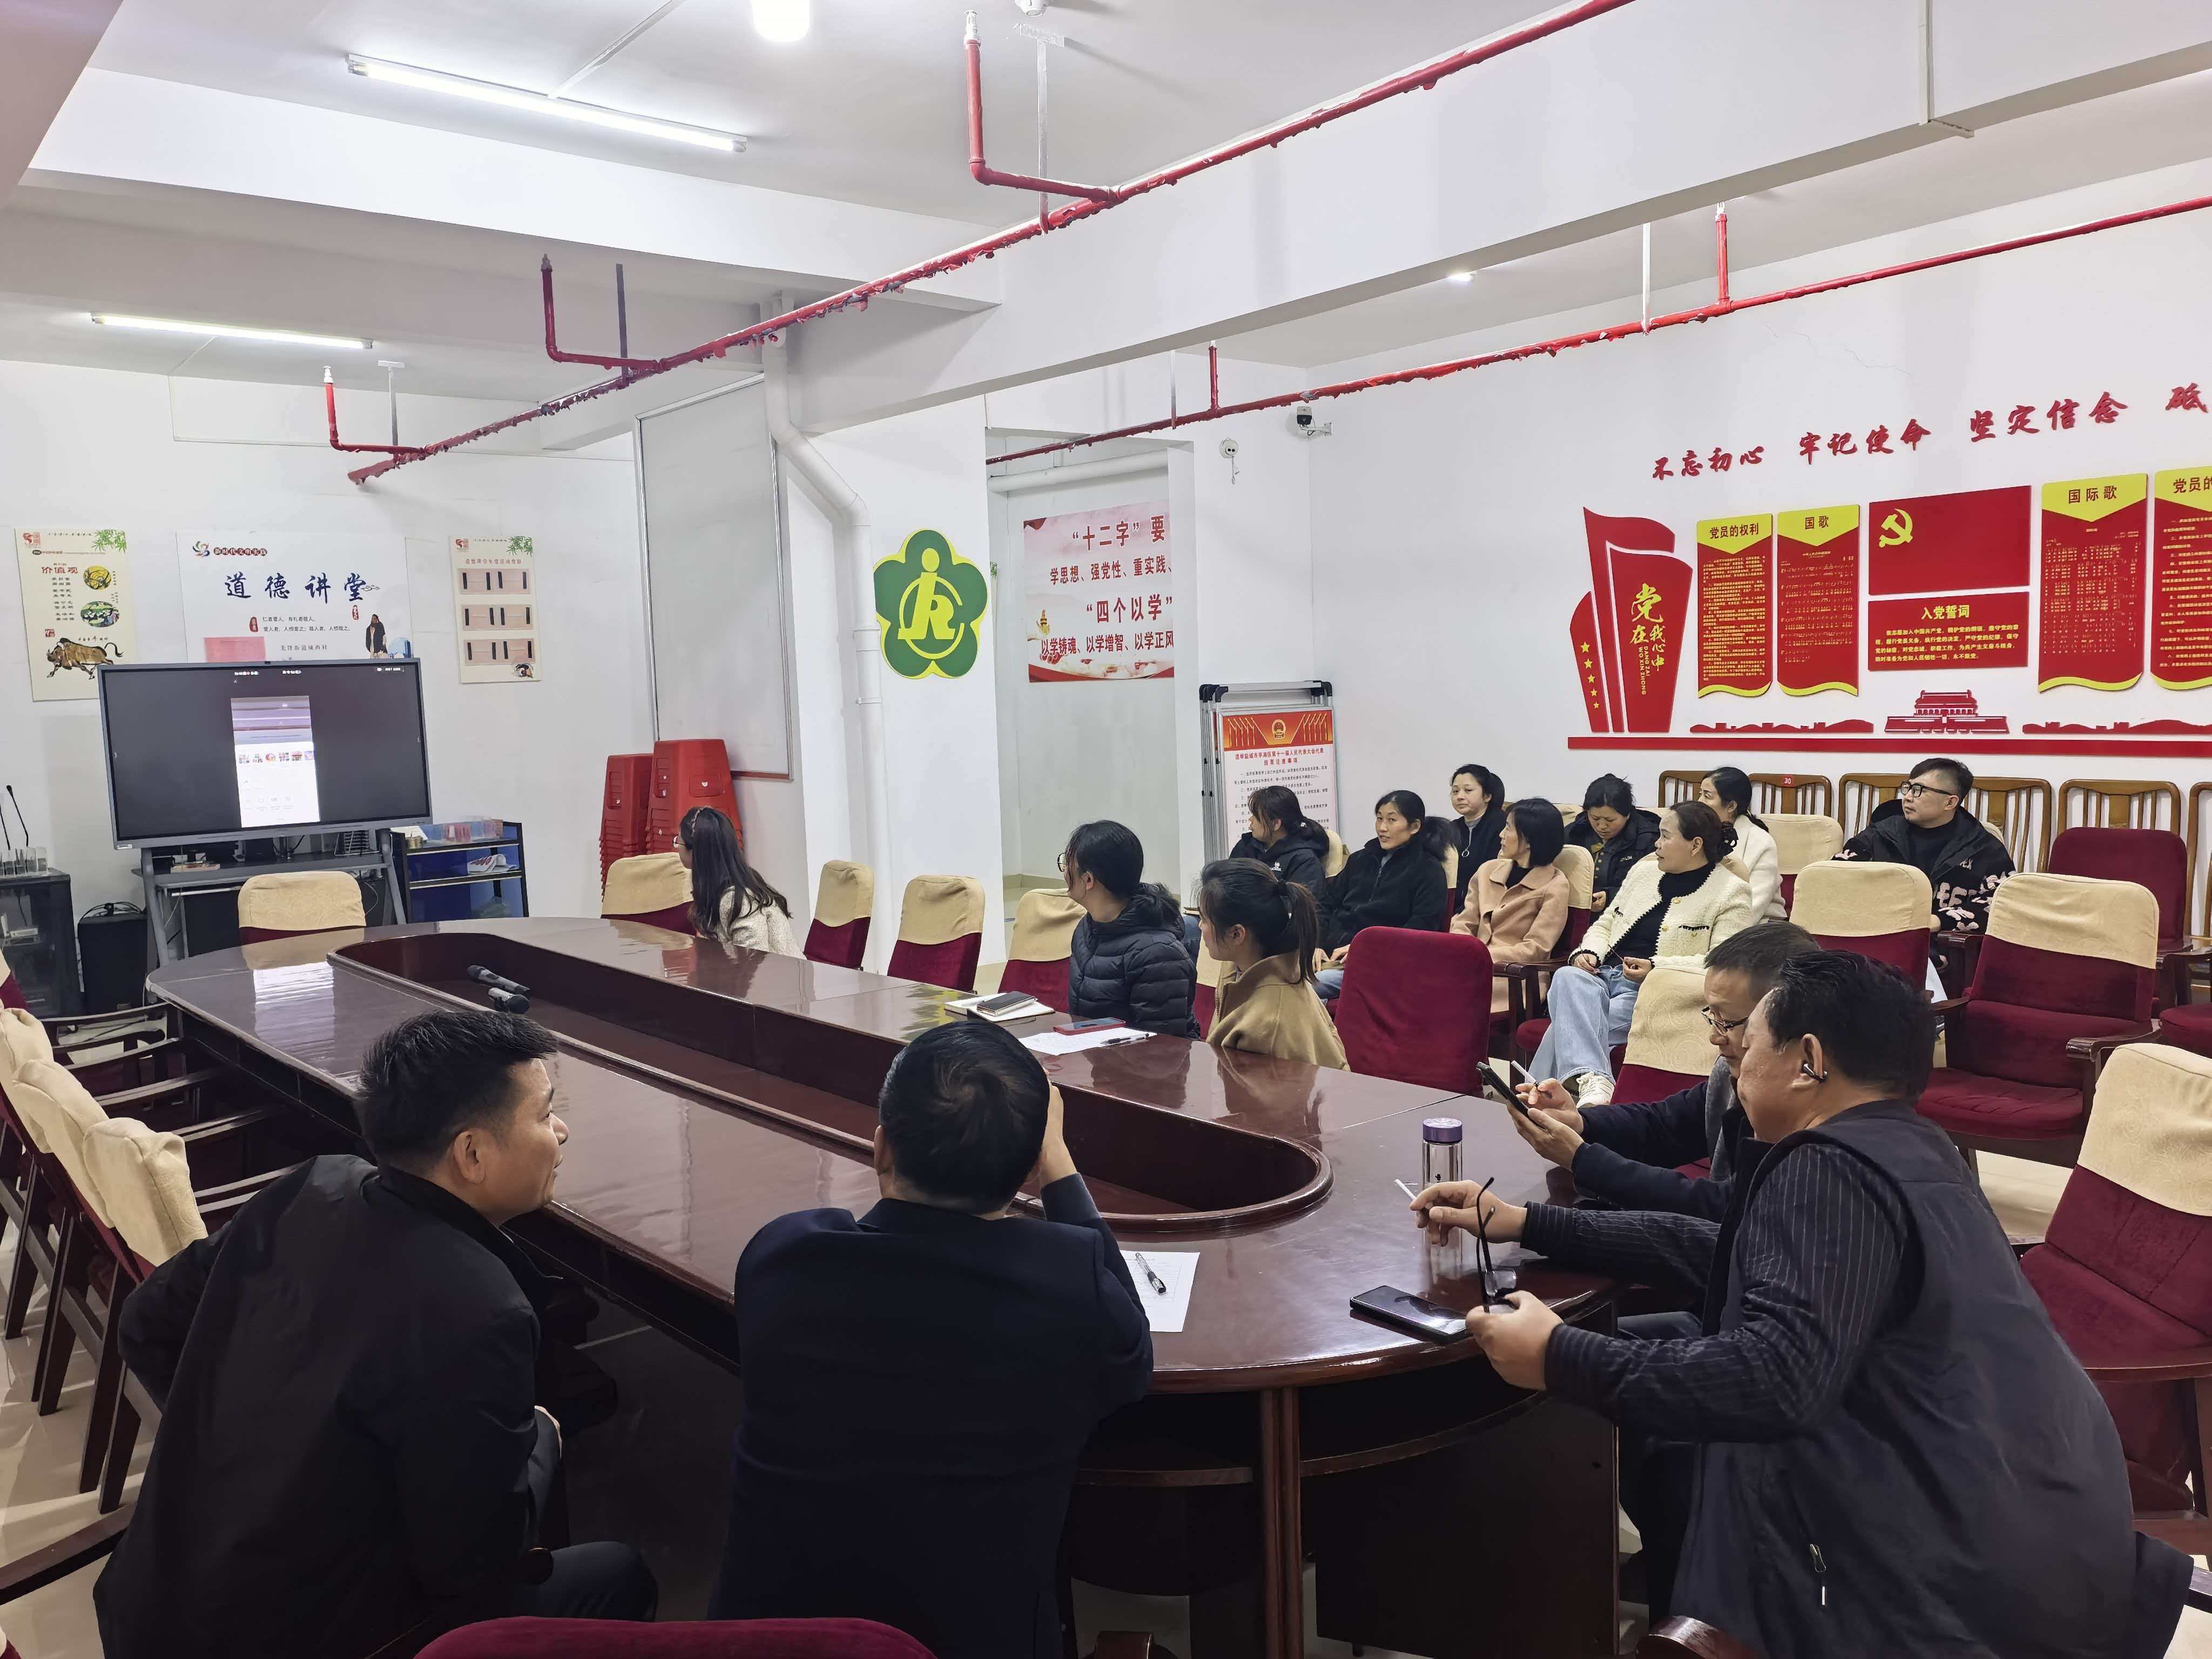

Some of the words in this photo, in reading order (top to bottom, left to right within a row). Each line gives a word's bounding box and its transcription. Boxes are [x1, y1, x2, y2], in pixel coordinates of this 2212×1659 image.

[1653, 446, 1764, 480] 不忘初心
[1799, 419, 1931, 464] 牢记使命
[1970, 392, 2128, 442] 坚定信念
[2165, 382, 2208, 413] 砥
[2068, 485, 2117, 504] 国际歌
[1710, 523, 1759, 539] 党员的权利
[1805, 515, 1829, 530] 国歌
[1050, 554, 1172, 585] 学思想、强党性、重实践、
[224, 571, 367, 604] 道德讲堂
[1086, 594, 1172, 623] “四个以学”
[1921, 604, 1970, 620] 入党誓词
[1041, 630, 1174, 655] 以学铸魂、以学增智、以学正风
[1638, 646, 1643, 658] WO
